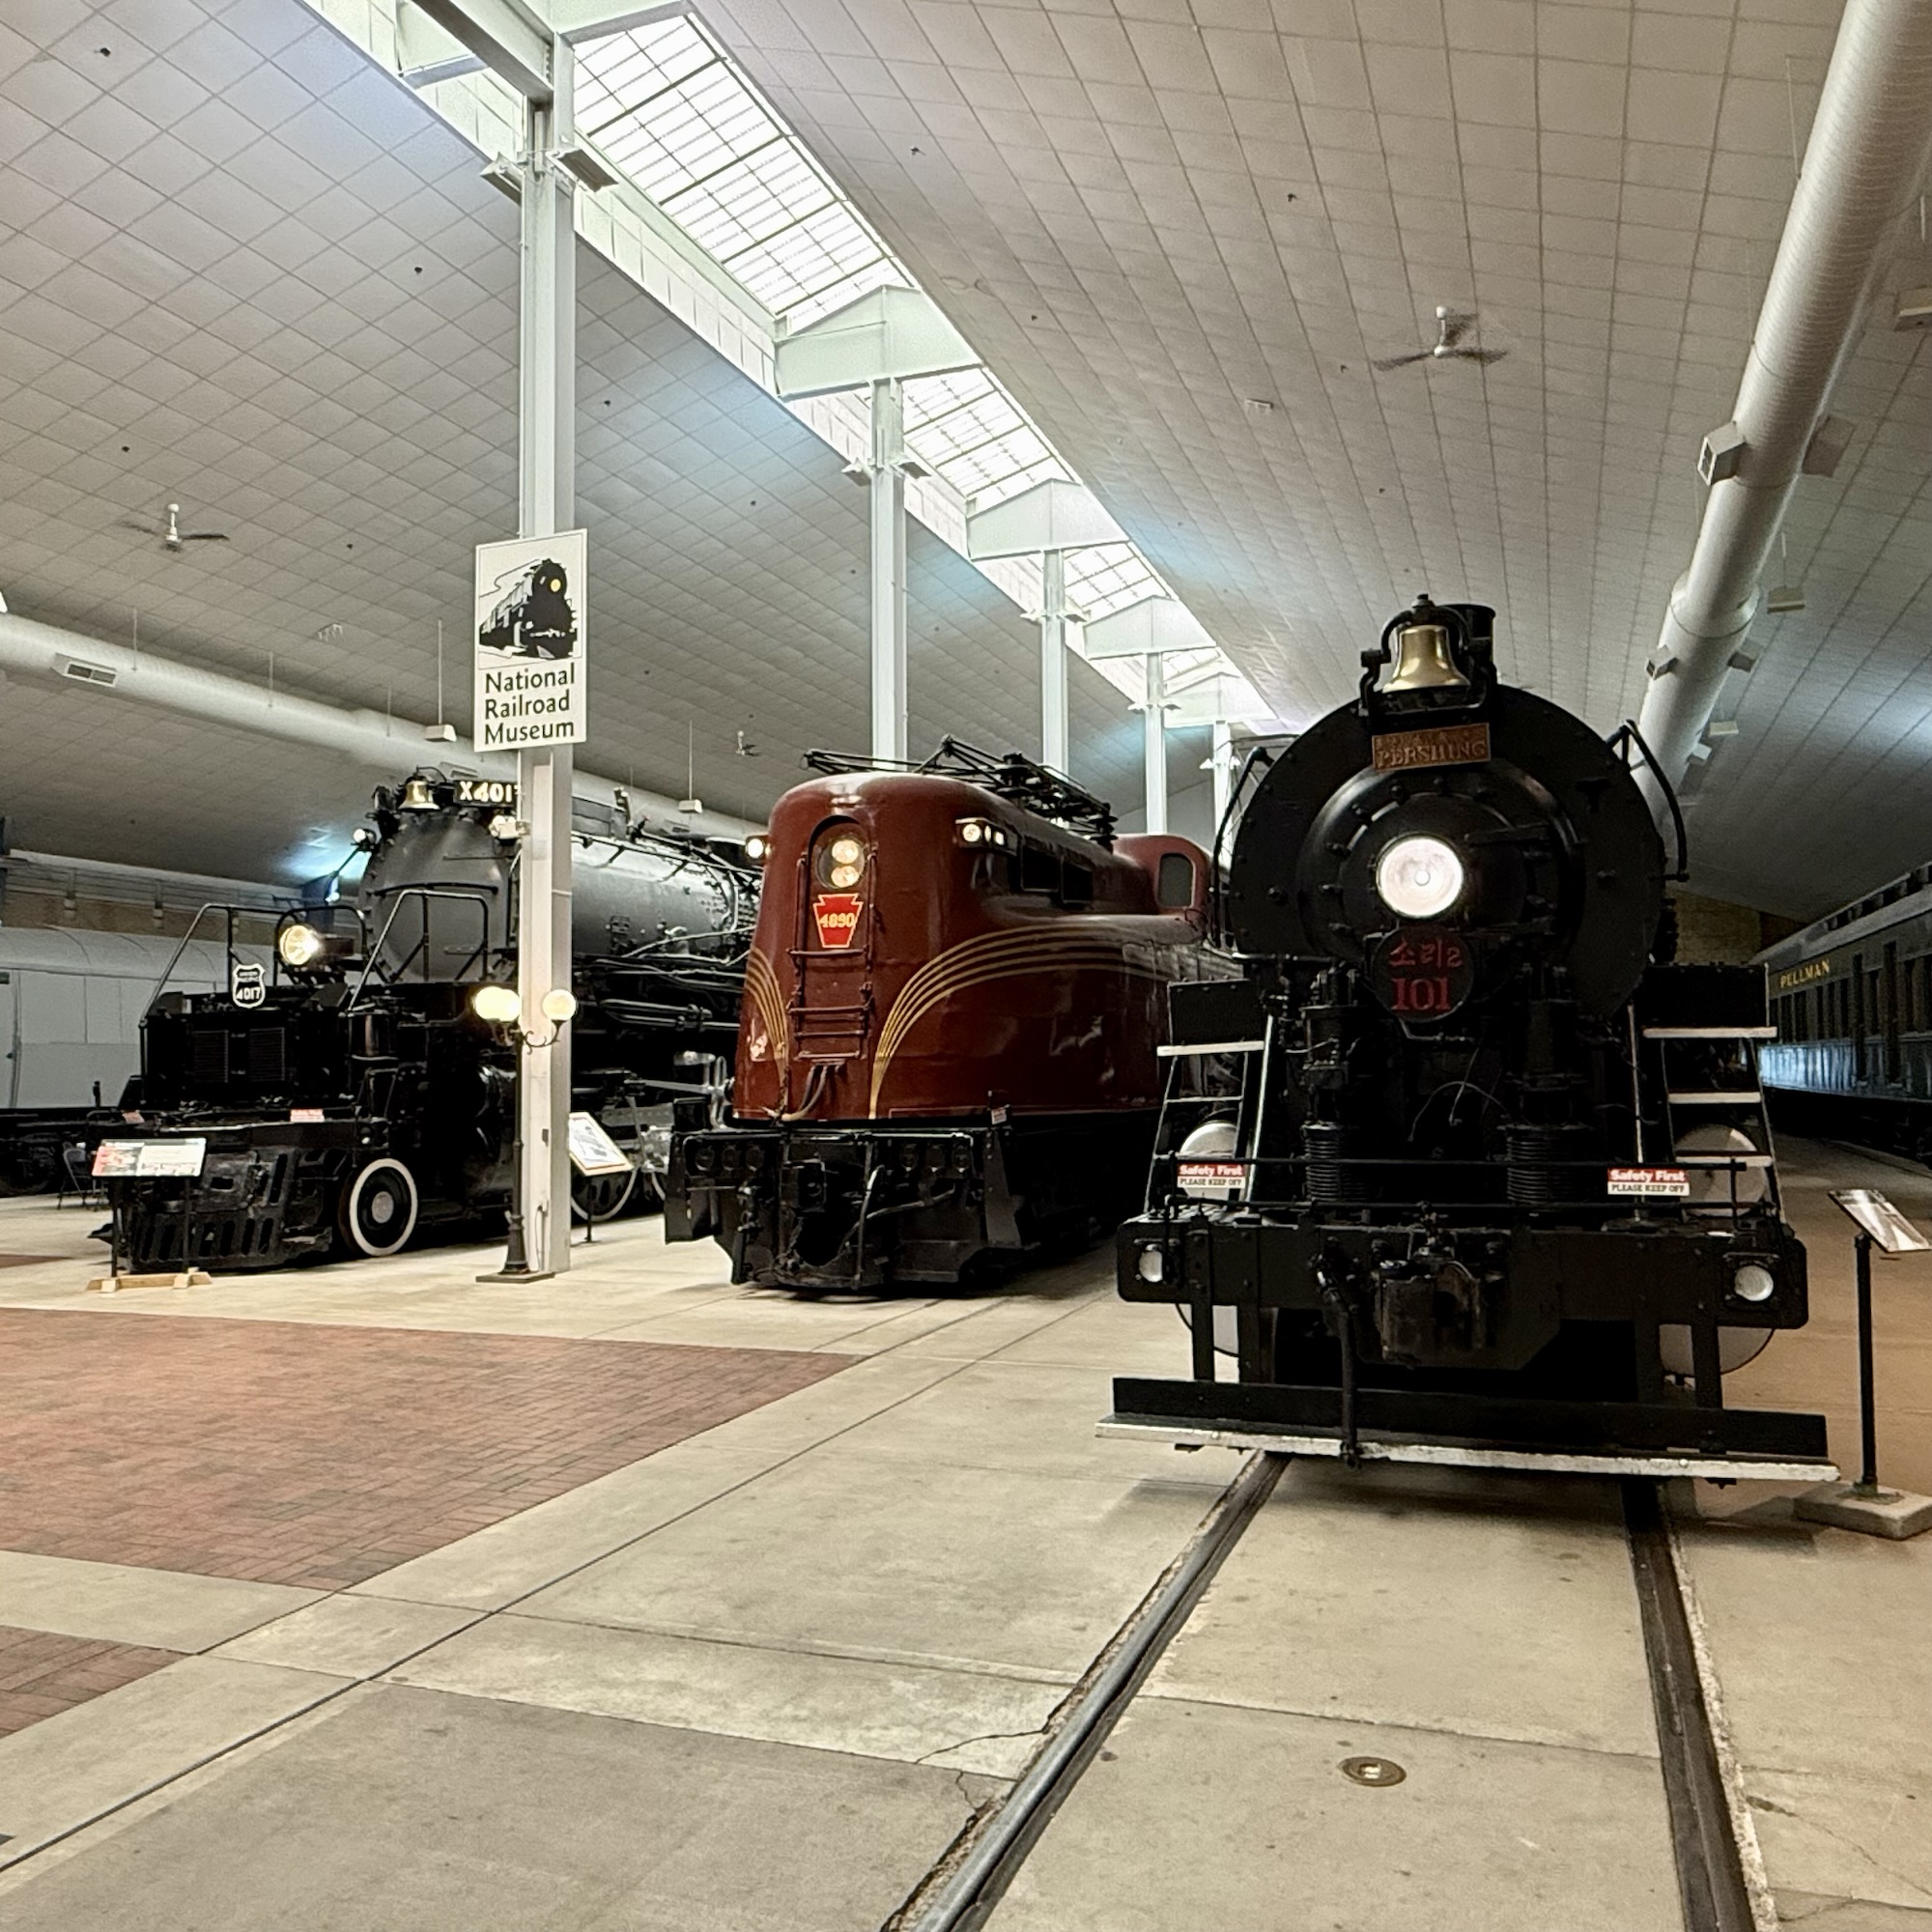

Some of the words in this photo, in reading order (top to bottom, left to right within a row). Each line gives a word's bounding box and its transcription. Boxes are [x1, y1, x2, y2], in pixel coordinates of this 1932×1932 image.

[485, 663, 575, 694] National
[485, 689, 571, 720] Railroad
[484, 722, 575, 745] Museum
[1376, 741, 1486, 768] PERSHING
[819, 913, 855, 927] 4890
[236, 986, 261, 1000] 4017
[1391, 978, 1450, 1010] 101
[1179, 1164, 1215, 1178] Safety
[1217, 1164, 1243, 1176] First
[1610, 1169, 1654, 1183] Safety
[1655, 1169, 1686, 1181] First
